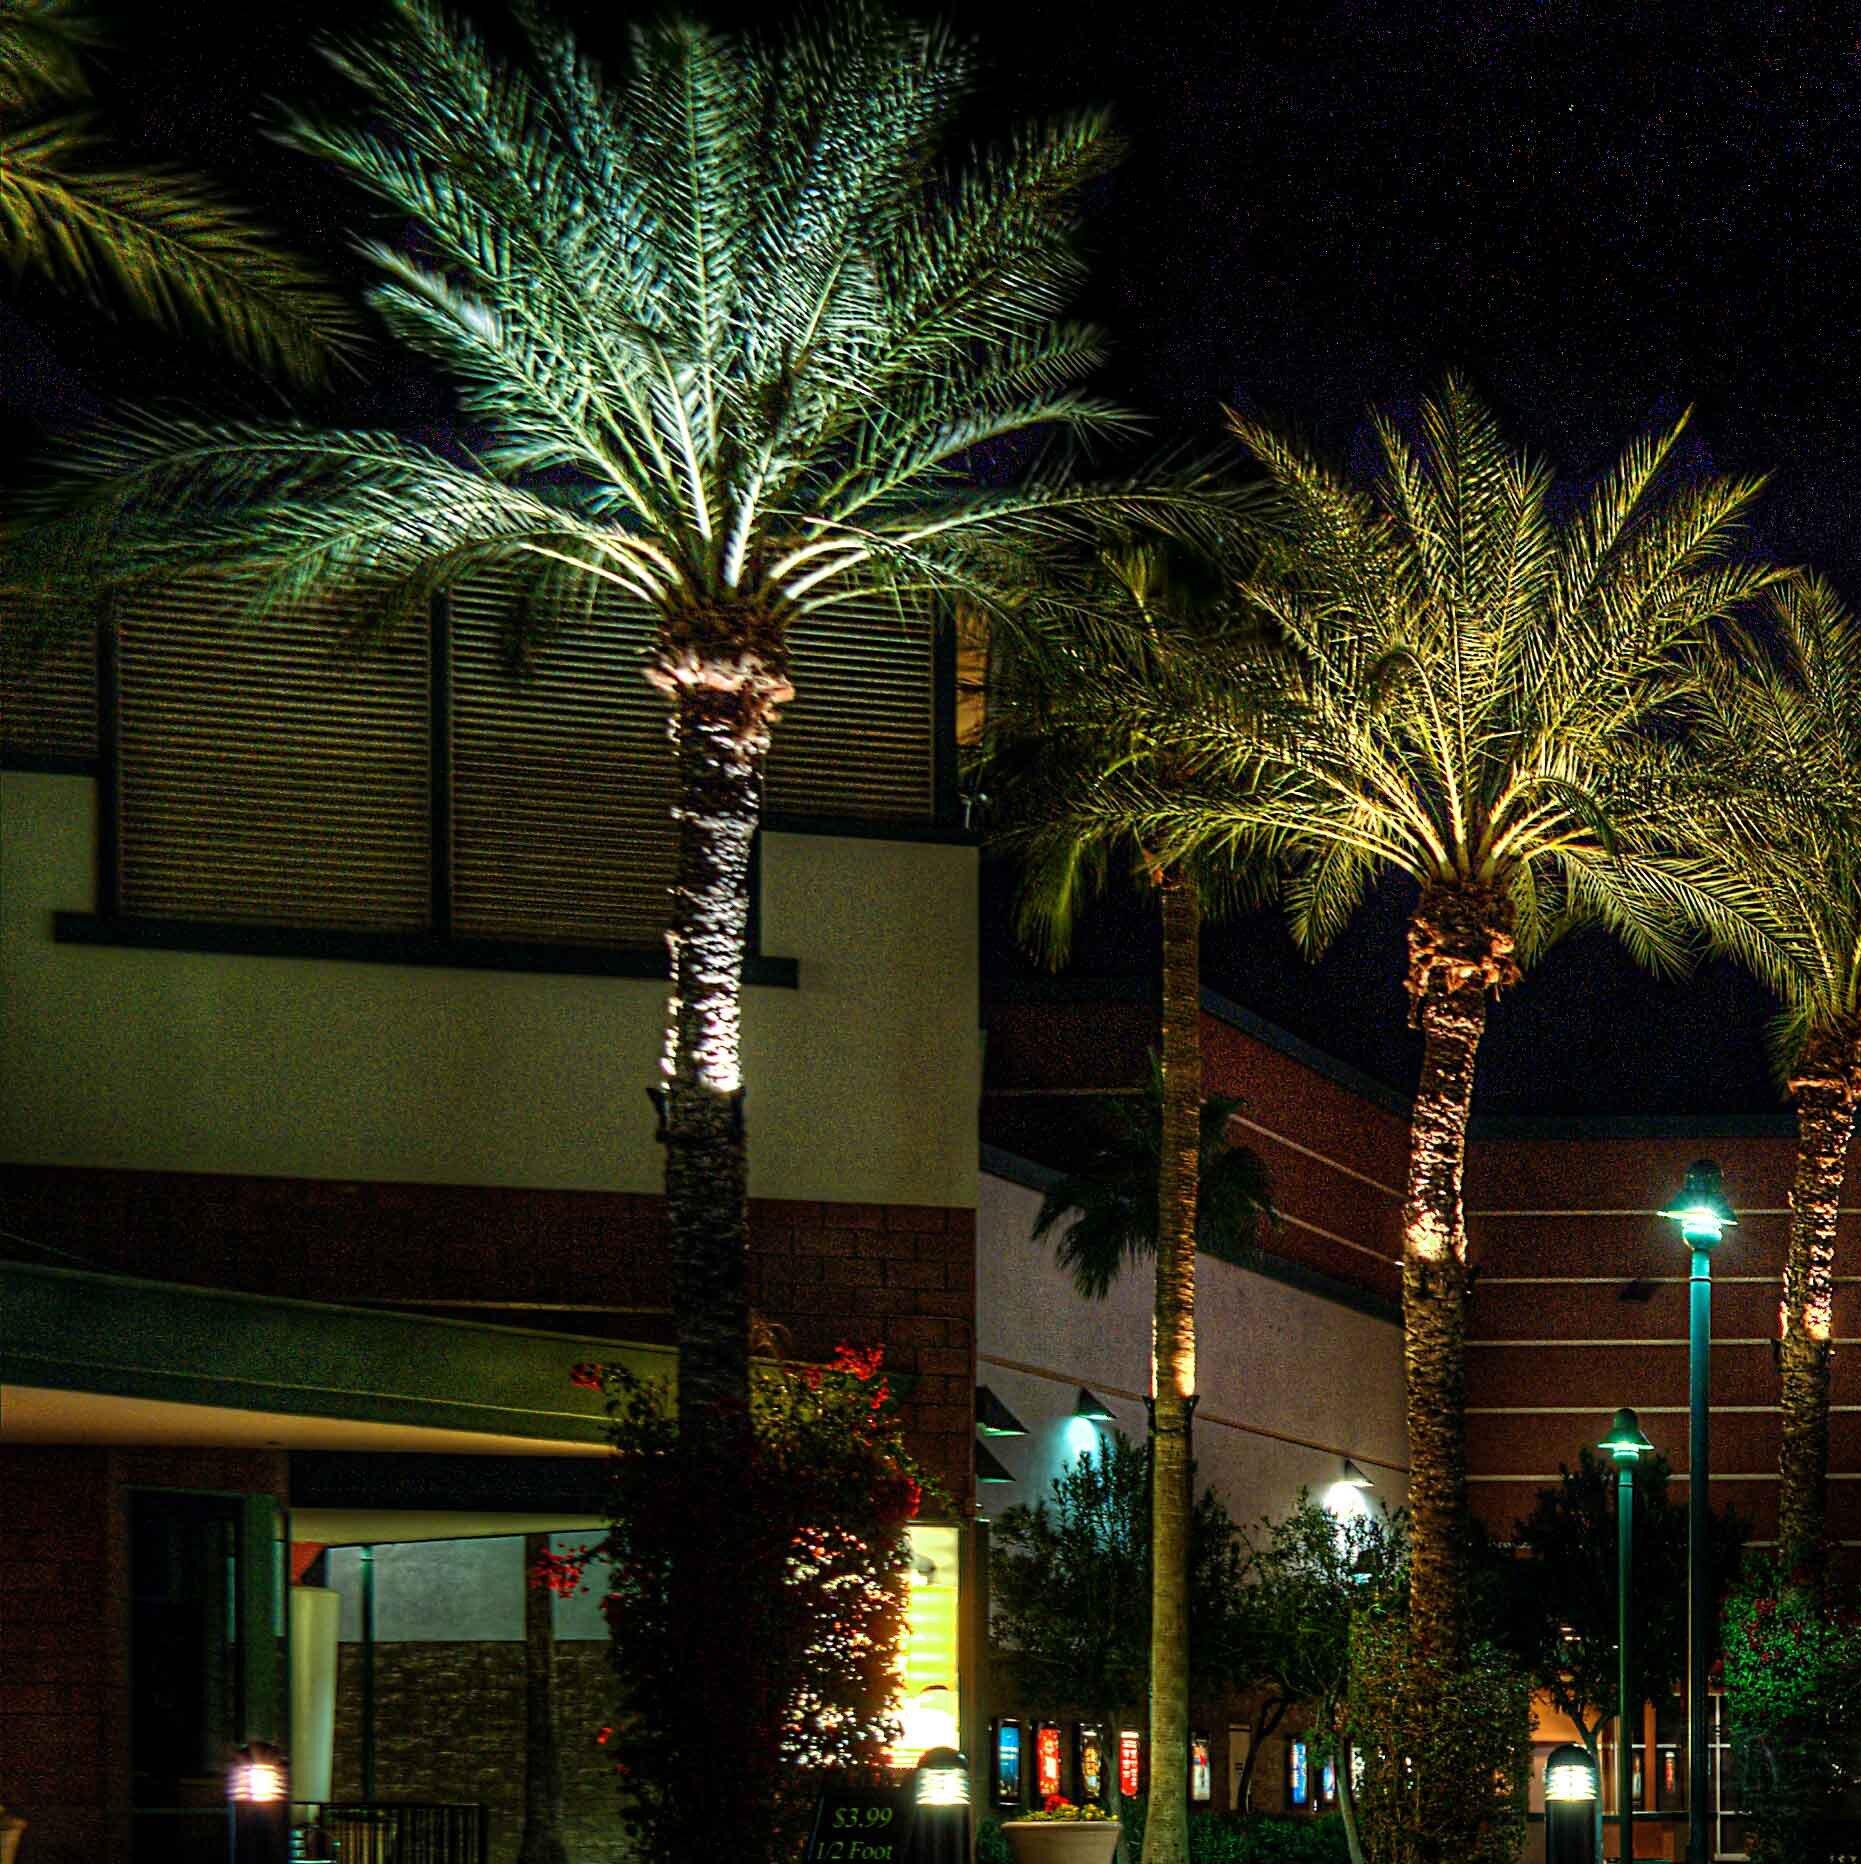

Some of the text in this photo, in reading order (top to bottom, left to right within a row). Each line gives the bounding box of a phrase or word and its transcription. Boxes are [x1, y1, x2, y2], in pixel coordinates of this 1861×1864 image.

[832, 1807, 894, 1829] $3.99
[816, 1841, 894, 1860] 1/2 Foot
